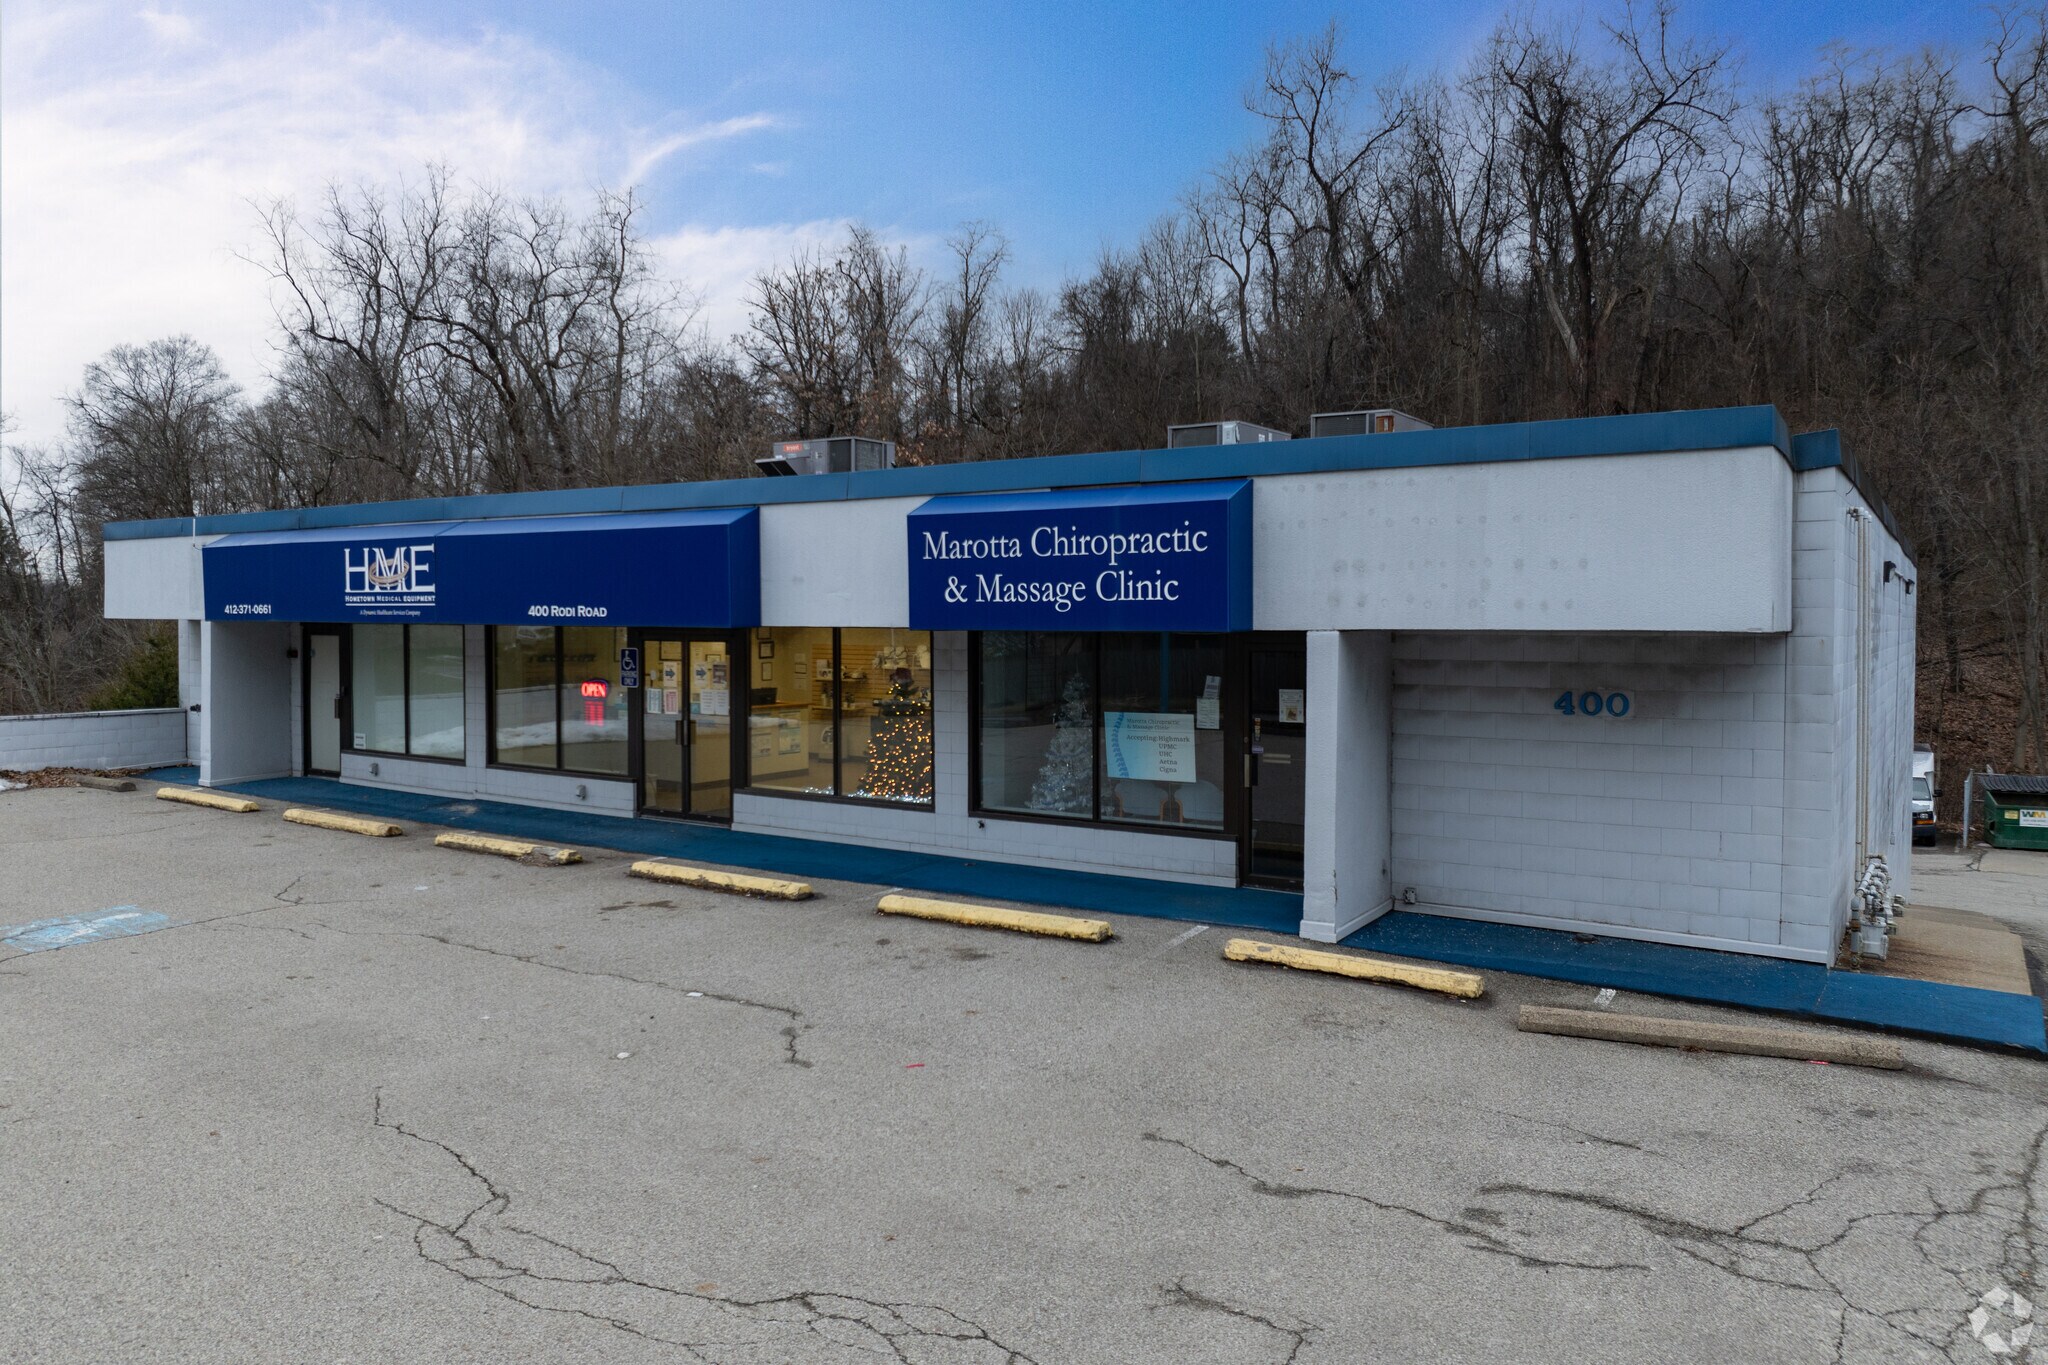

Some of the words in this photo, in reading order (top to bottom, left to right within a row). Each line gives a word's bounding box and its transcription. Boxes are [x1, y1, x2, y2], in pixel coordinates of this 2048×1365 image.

[922, 531, 1022, 560] Marotta
[1030, 520, 1208, 566] Chiropractic
[344, 543, 436, 594] HME
[944, 575, 968, 603] &
[975, 573, 1087, 613] Massage
[1095, 569, 1180, 602] Clinic
[224, 604, 272, 615] 412-371-0661
[528, 605, 550, 617] 400
[581, 682, 607, 698] OPEN
[1554, 691, 1630, 718] 400
[1158, 735, 1191, 743] Highmark
[1159, 766, 1178, 774] Cigna
